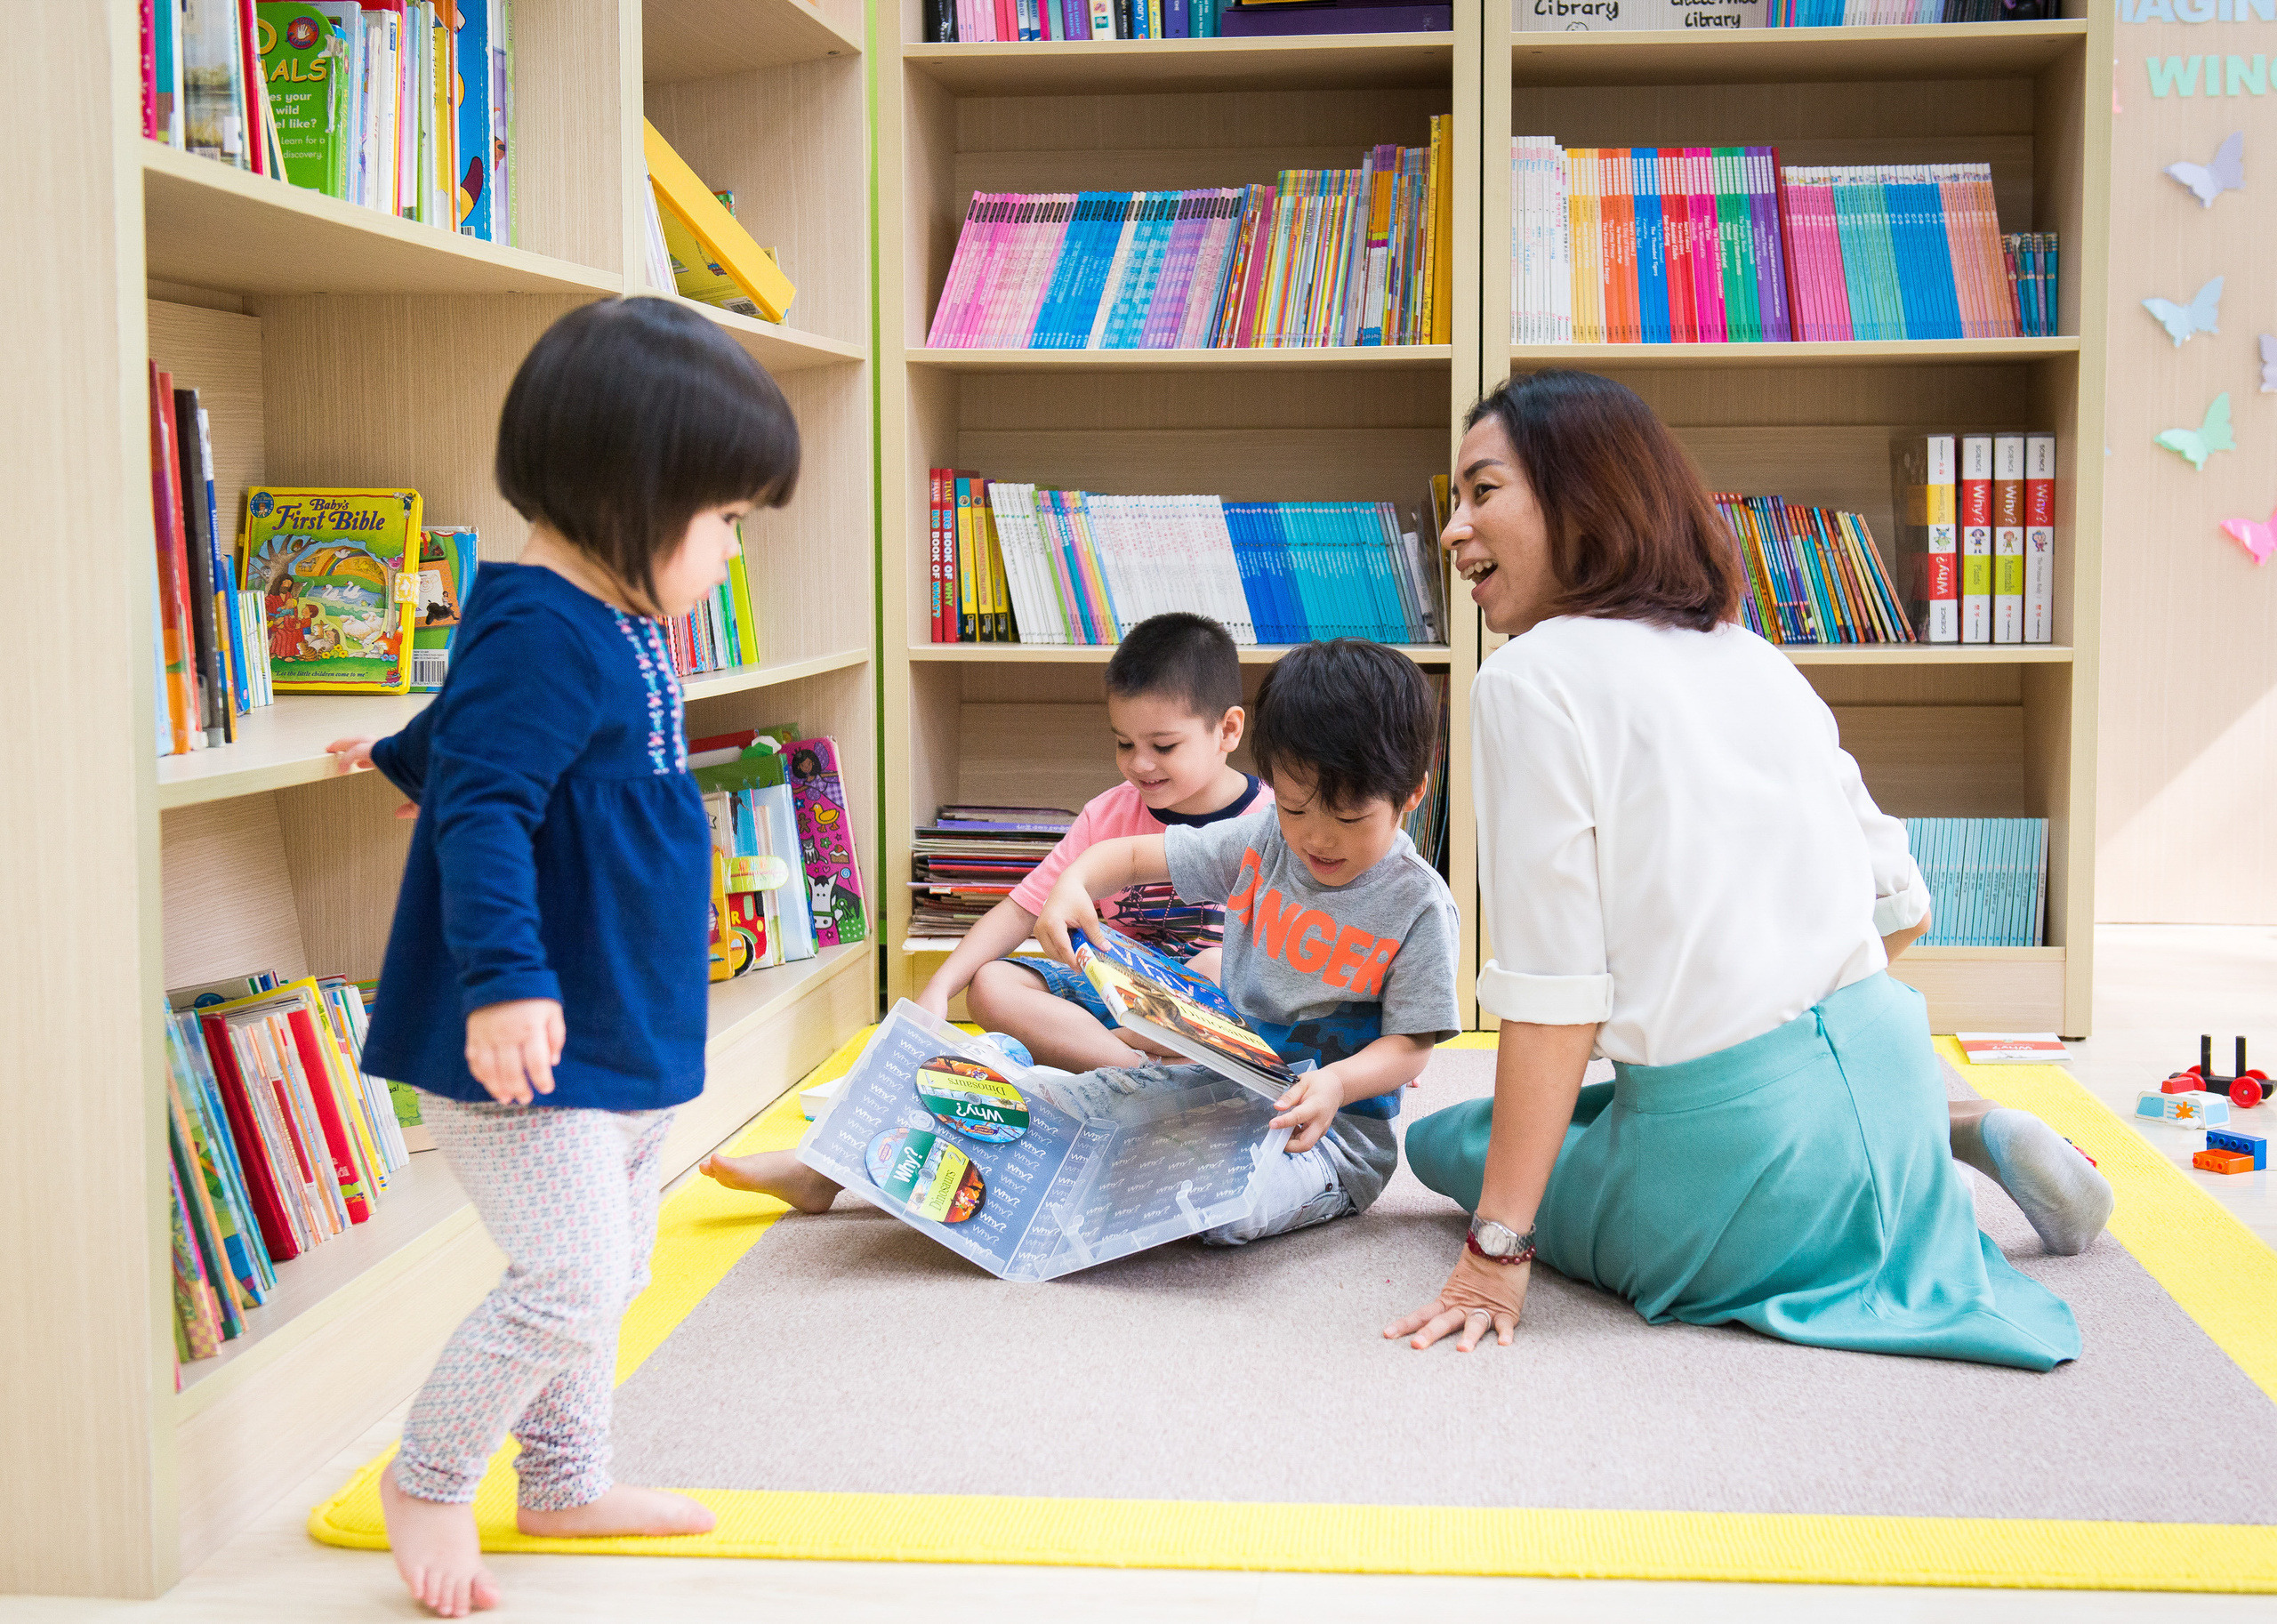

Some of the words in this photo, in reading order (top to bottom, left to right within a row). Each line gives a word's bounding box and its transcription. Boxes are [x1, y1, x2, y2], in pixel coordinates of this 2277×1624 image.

[1535, 0, 1619, 21] Library
[1685, 13, 1741, 28] Library
[2146, 54, 2277, 97] WIN
[276, 105, 299, 115] wild
[289, 118, 317, 128] like?
[306, 136, 318, 144] for
[943, 480, 952, 503] TIME
[2035, 483, 2048, 523] Why?
[309, 499, 349, 511] Baby's
[1972, 485, 1985, 524] Why?
[2004, 485, 2017, 524] Why?
[272, 503, 325, 530] First
[328, 510, 385, 530] Bible
[932, 509, 940, 528] BIG
[943, 510, 952, 529] BIG
[932, 531, 940, 562] BOOK
[943, 531, 952, 562] BOOK
[932, 564, 940, 579] OF
[944, 564, 953, 579] OF
[1936, 556, 1950, 595] Why?
[2004, 559, 2015, 593] Animals
[933, 581, 941, 618] WHAT?
[945, 582, 953, 607] WHY
[948, 1077, 1006, 1096] Dinosaurs
[956, 1101, 1004, 1123] Why?
[893, 1146, 923, 1183] Why?
[947, 1151, 966, 1166] 2
[929, 1169, 956, 1211] Dinosaurs
